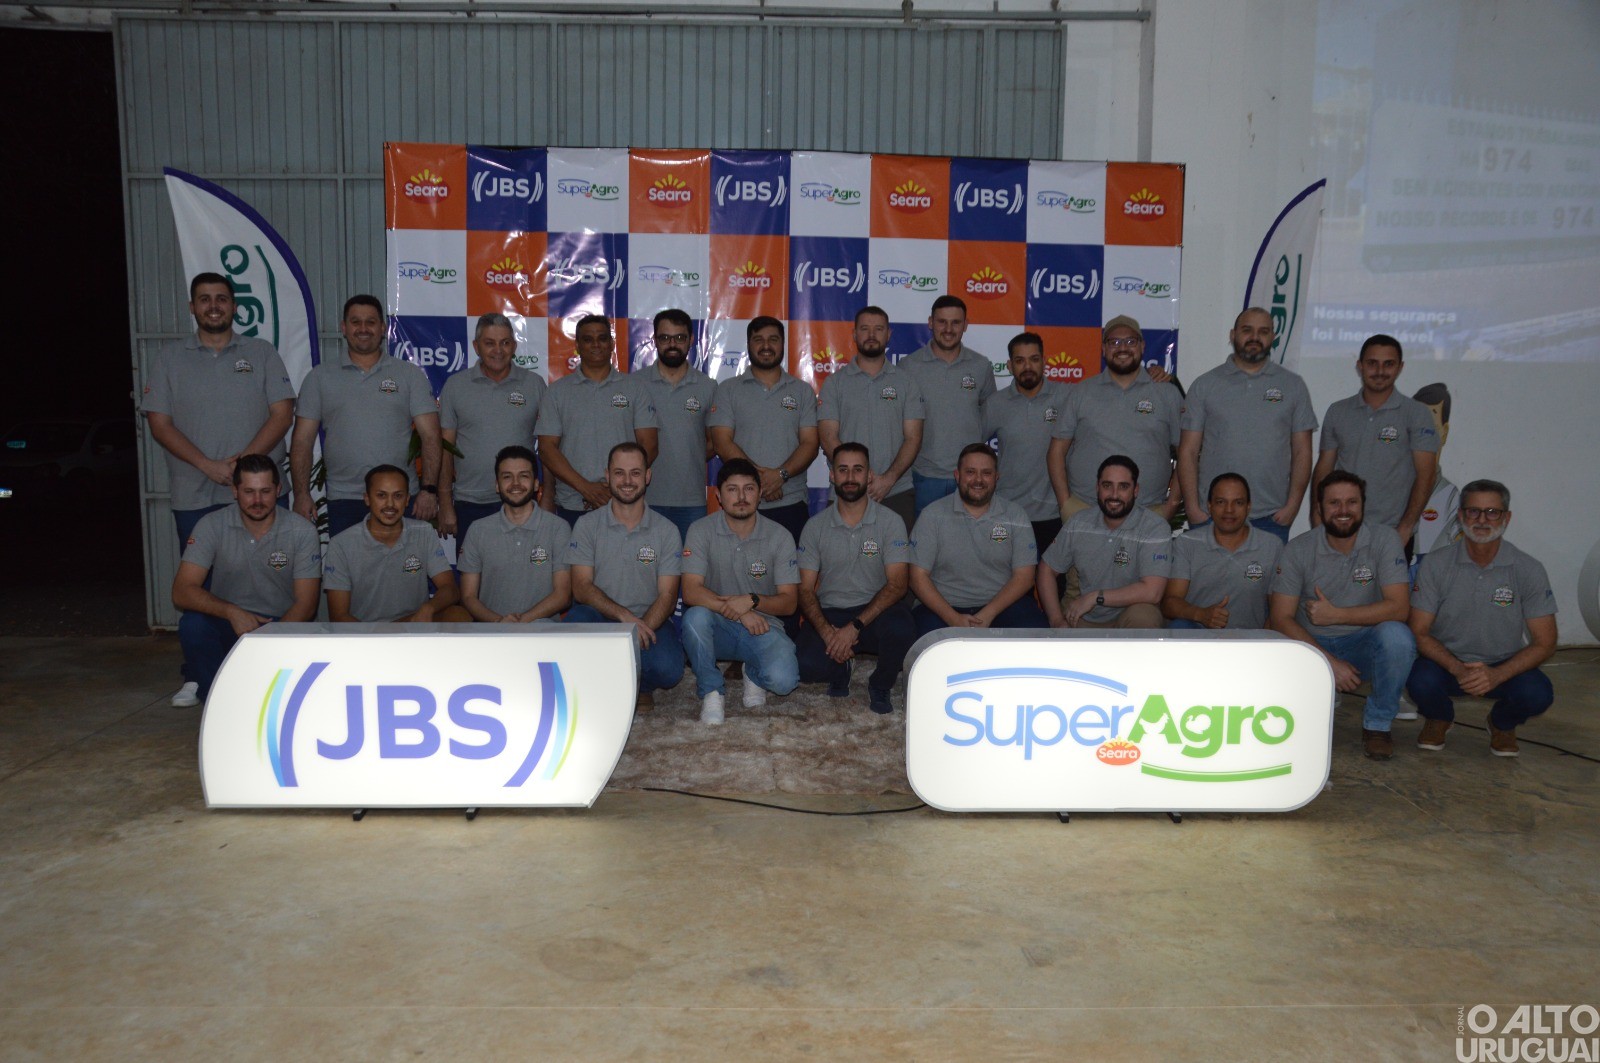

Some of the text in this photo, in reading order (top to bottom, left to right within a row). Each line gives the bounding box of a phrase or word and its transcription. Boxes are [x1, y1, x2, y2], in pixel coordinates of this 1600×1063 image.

[1483, 146, 1531, 173] 974
[405, 183, 448, 198] Seara
[557, 182, 619, 196] SuperAgro
[648, 188, 691, 202] Seara
[800, 185, 860, 200] SuperAgro
[889, 193, 931, 208] Seara
[1036, 193, 1096, 209] SuperAgro
[1124, 200, 1164, 216] Seara
[1552, 206, 1594, 230] 974
[728, 273, 770, 288] Seara
[878, 273, 938, 288] SuperAgro
[966, 279, 1008, 294] Seara
[1112, 280, 1171, 296] SuperAgro
[1313, 306, 1457, 325] Nossa segurança
[1312, 327, 1333, 341] foi
[1043, 365, 1083, 378] Seara
[942, 691, 1295, 761] SuperAgro
[1098, 746, 1140, 760] Seara
